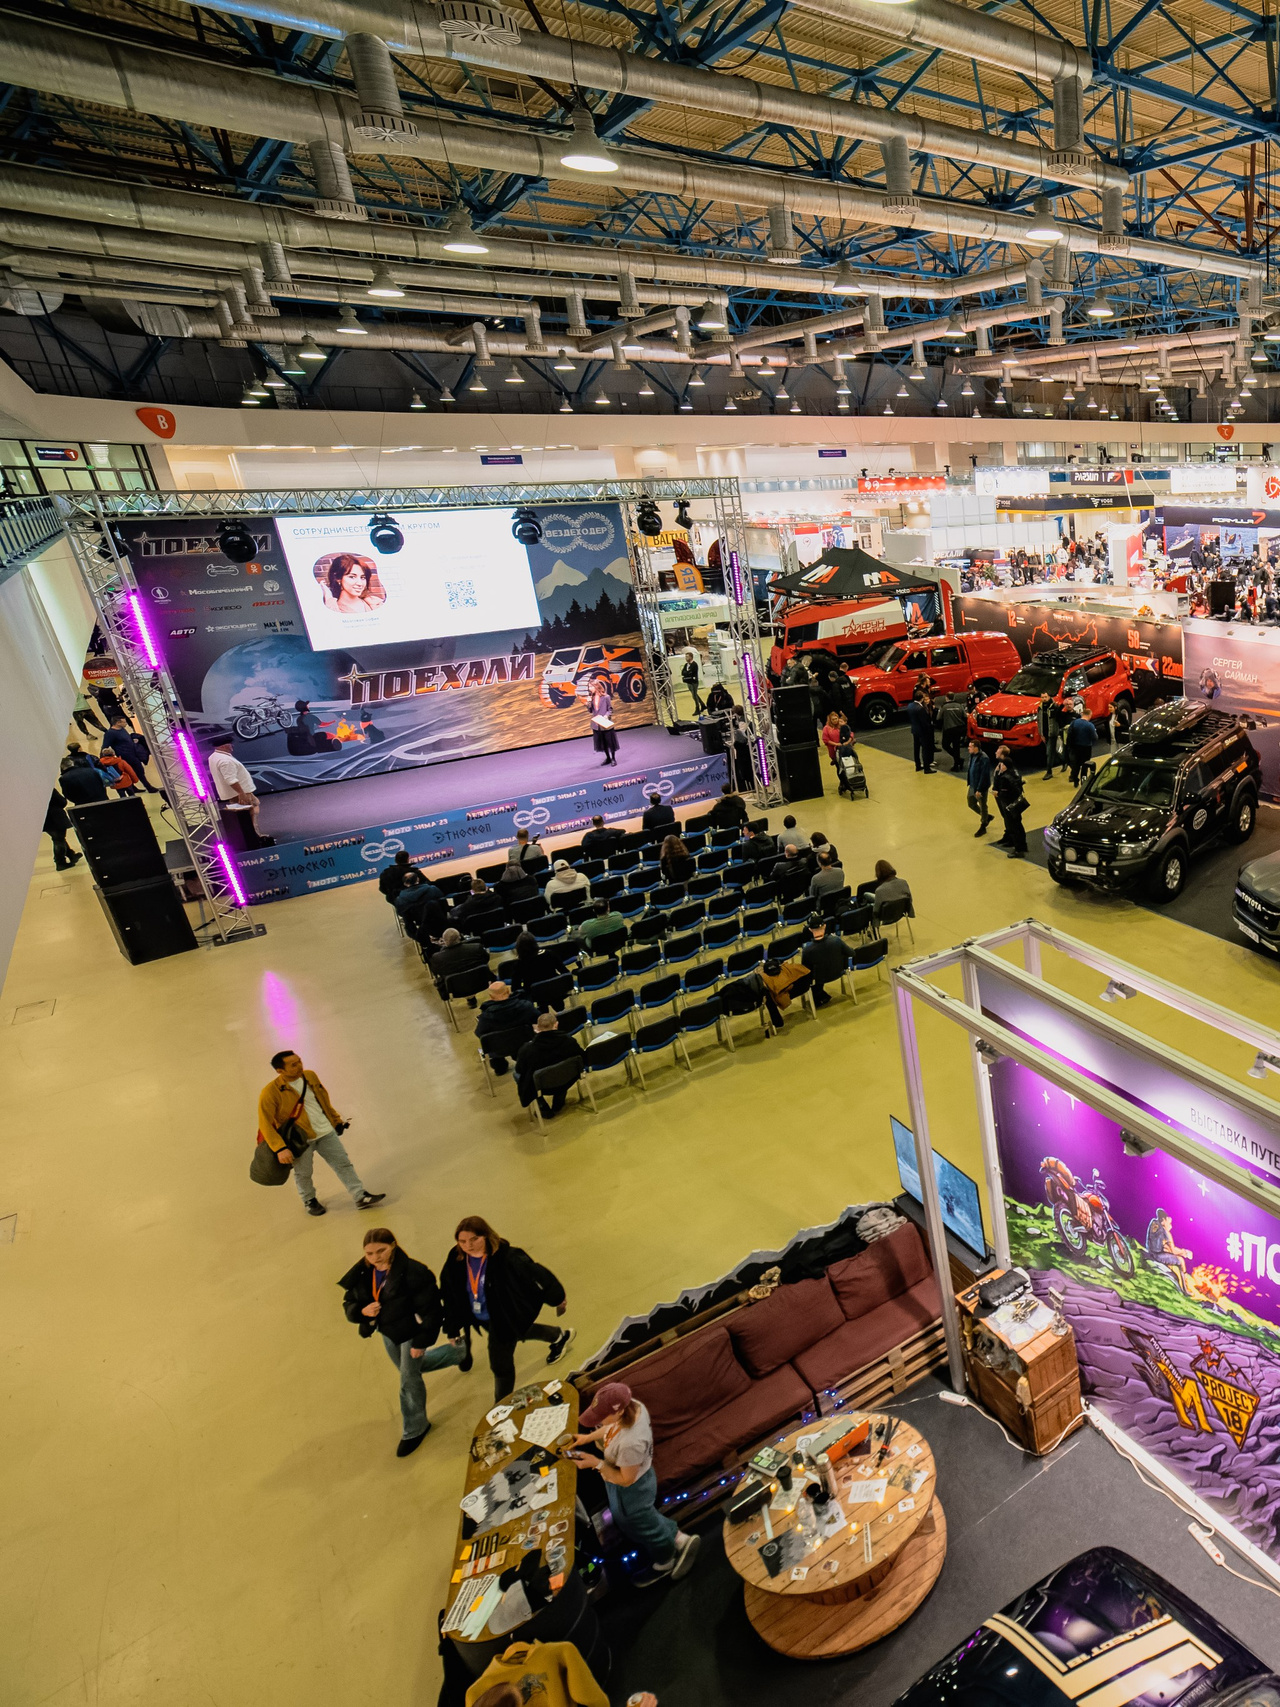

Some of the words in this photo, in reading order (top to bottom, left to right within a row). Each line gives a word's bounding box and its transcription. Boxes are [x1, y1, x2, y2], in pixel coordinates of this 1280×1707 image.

[1074, 472, 1099, 482] PARSUN
[292, 525, 377, 537] СОТРУДНИЧЕСТВ
[407, 522, 441, 531] КРУГОМ
[545, 526, 608, 538] ВЕЗДЕХОДЕР
[142, 534, 272, 557] ПОЕХИ
[170, 628, 196, 636] АВТО
[842, 619, 885, 638] ТАЙФУН
[1127, 629, 1140, 649] 58
[1212, 656, 1244, 670] СЕРГЕЙ
[351, 652, 536, 706] ПОЕХАЛИ
[1224, 669, 1258, 684] САЙМАН
[1241, 891, 1262, 912] TOYOTA
[1190, 1107, 1248, 1152] ВЫСТАВКА
[1145, 1356, 1161, 1377] SKILL
[1202, 1376, 1256, 1413] PROJECT
[1221, 1407, 1243, 1432] 18
